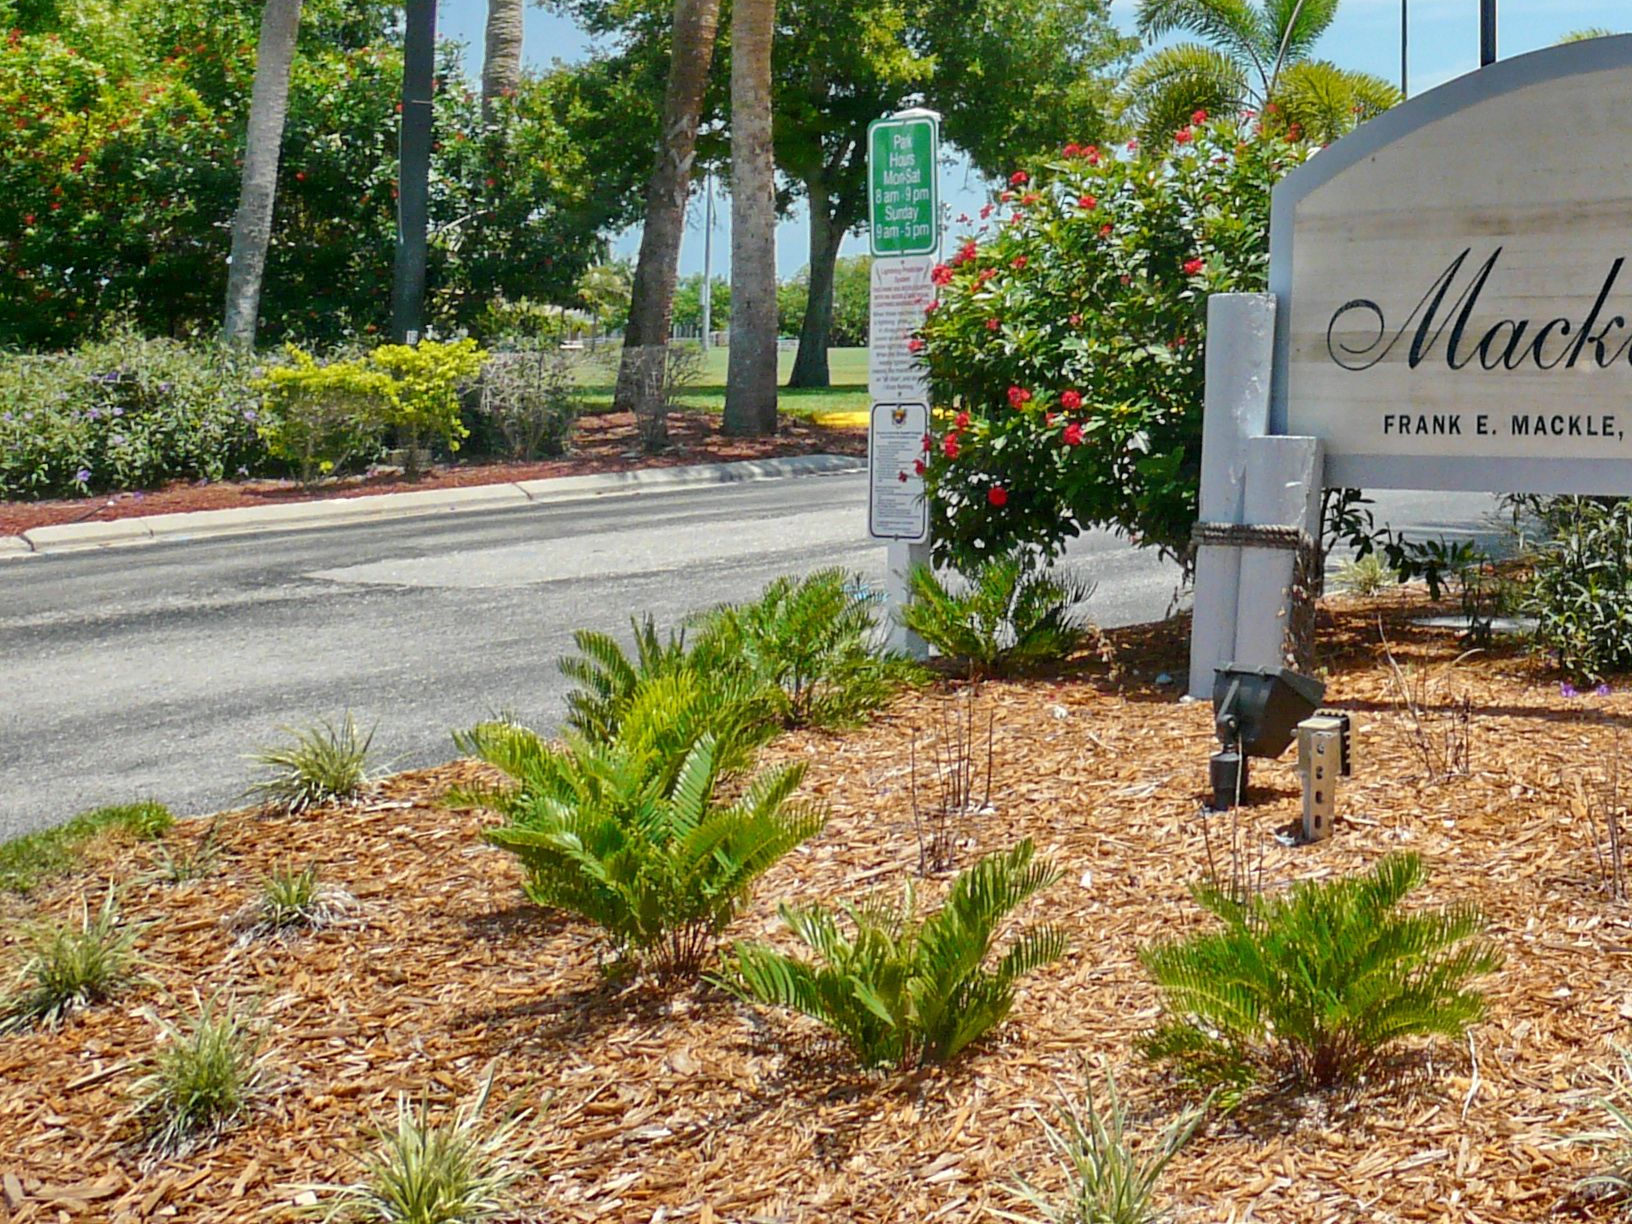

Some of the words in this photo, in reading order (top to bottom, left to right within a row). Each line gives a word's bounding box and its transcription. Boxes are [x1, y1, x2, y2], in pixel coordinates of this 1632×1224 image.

[893, 134, 912, 150] Park
[889, 151, 916, 168] Hours
[875, 188, 882, 204] 8
[883, 190, 900, 203] am
[905, 186, 912, 201] 9
[913, 188, 929, 204] pm
[885, 205, 919, 222] Sunday
[876, 223, 882, 239] 9
[883, 226, 900, 239] am
[905, 222, 911, 237] 5
[912, 224, 930, 240] pm
[1384, 414, 1461, 436] FRANK
[1476, 414, 1497, 436] E.
[1511, 415, 1626, 442] MACKLE,
